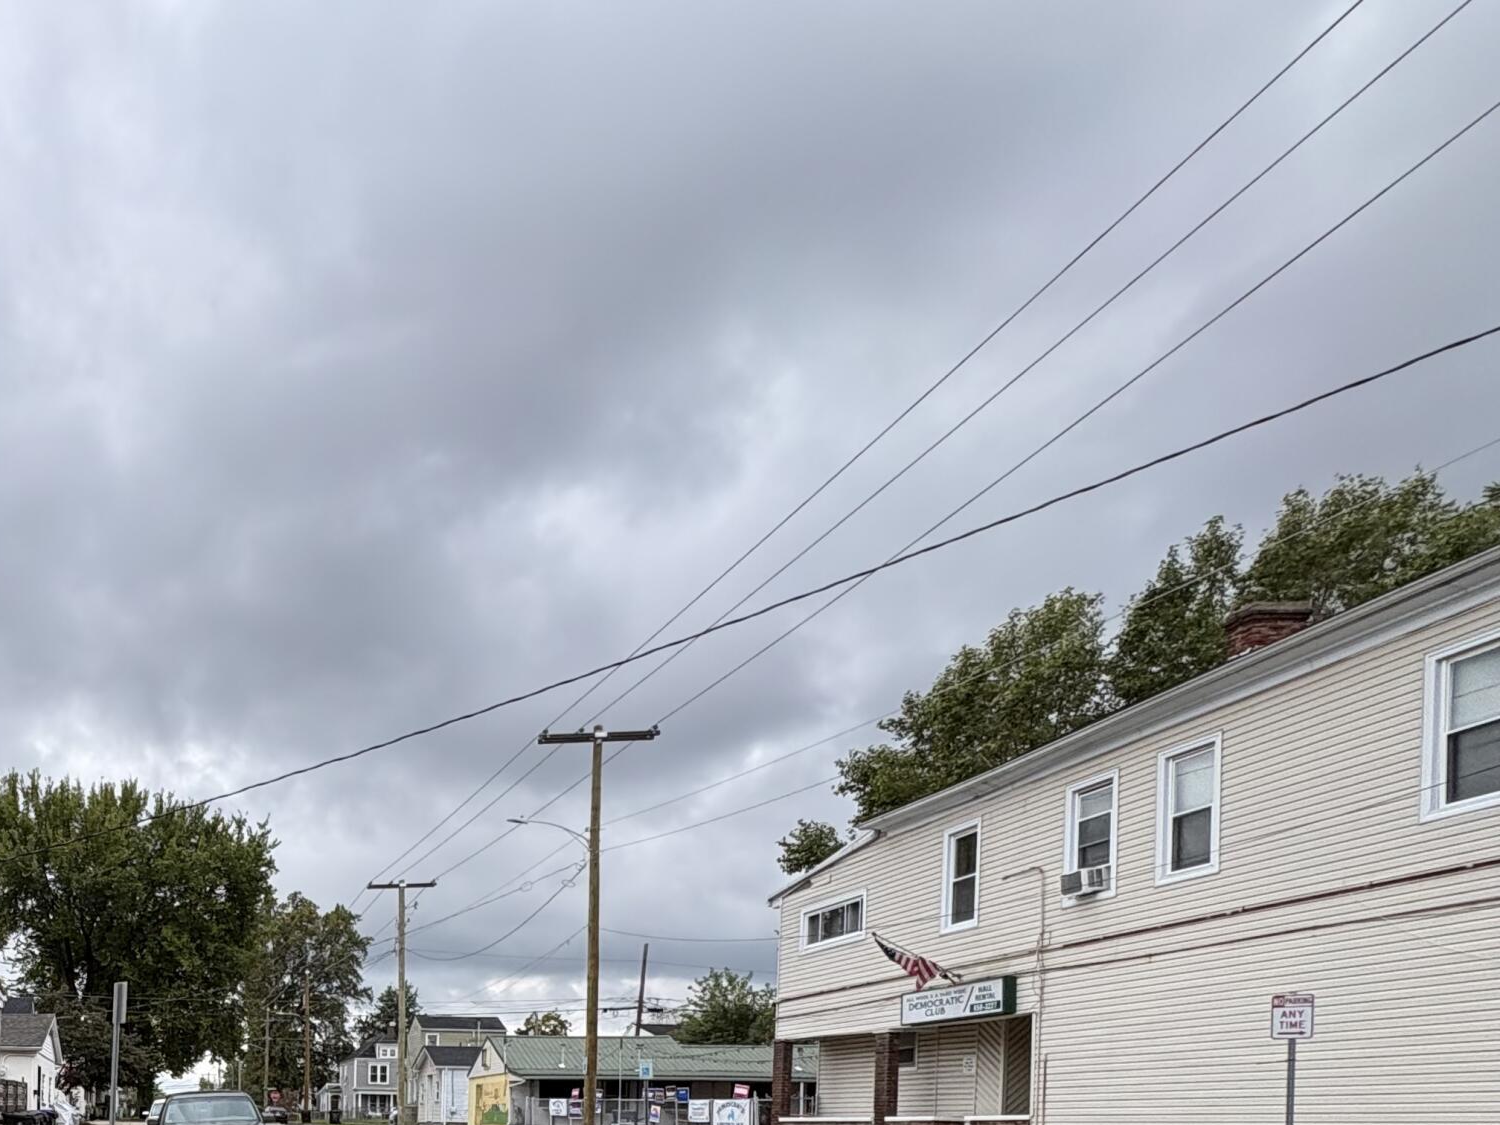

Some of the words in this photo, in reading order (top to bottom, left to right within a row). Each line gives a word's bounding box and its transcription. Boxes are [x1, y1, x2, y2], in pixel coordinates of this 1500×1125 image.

[908, 995, 964, 1011] DEMOCRATIC
[925, 1007, 946, 1017] CLUB
[1281, 1010, 1304, 1018] ANY
[1279, 1020, 1306, 1029] TIME
